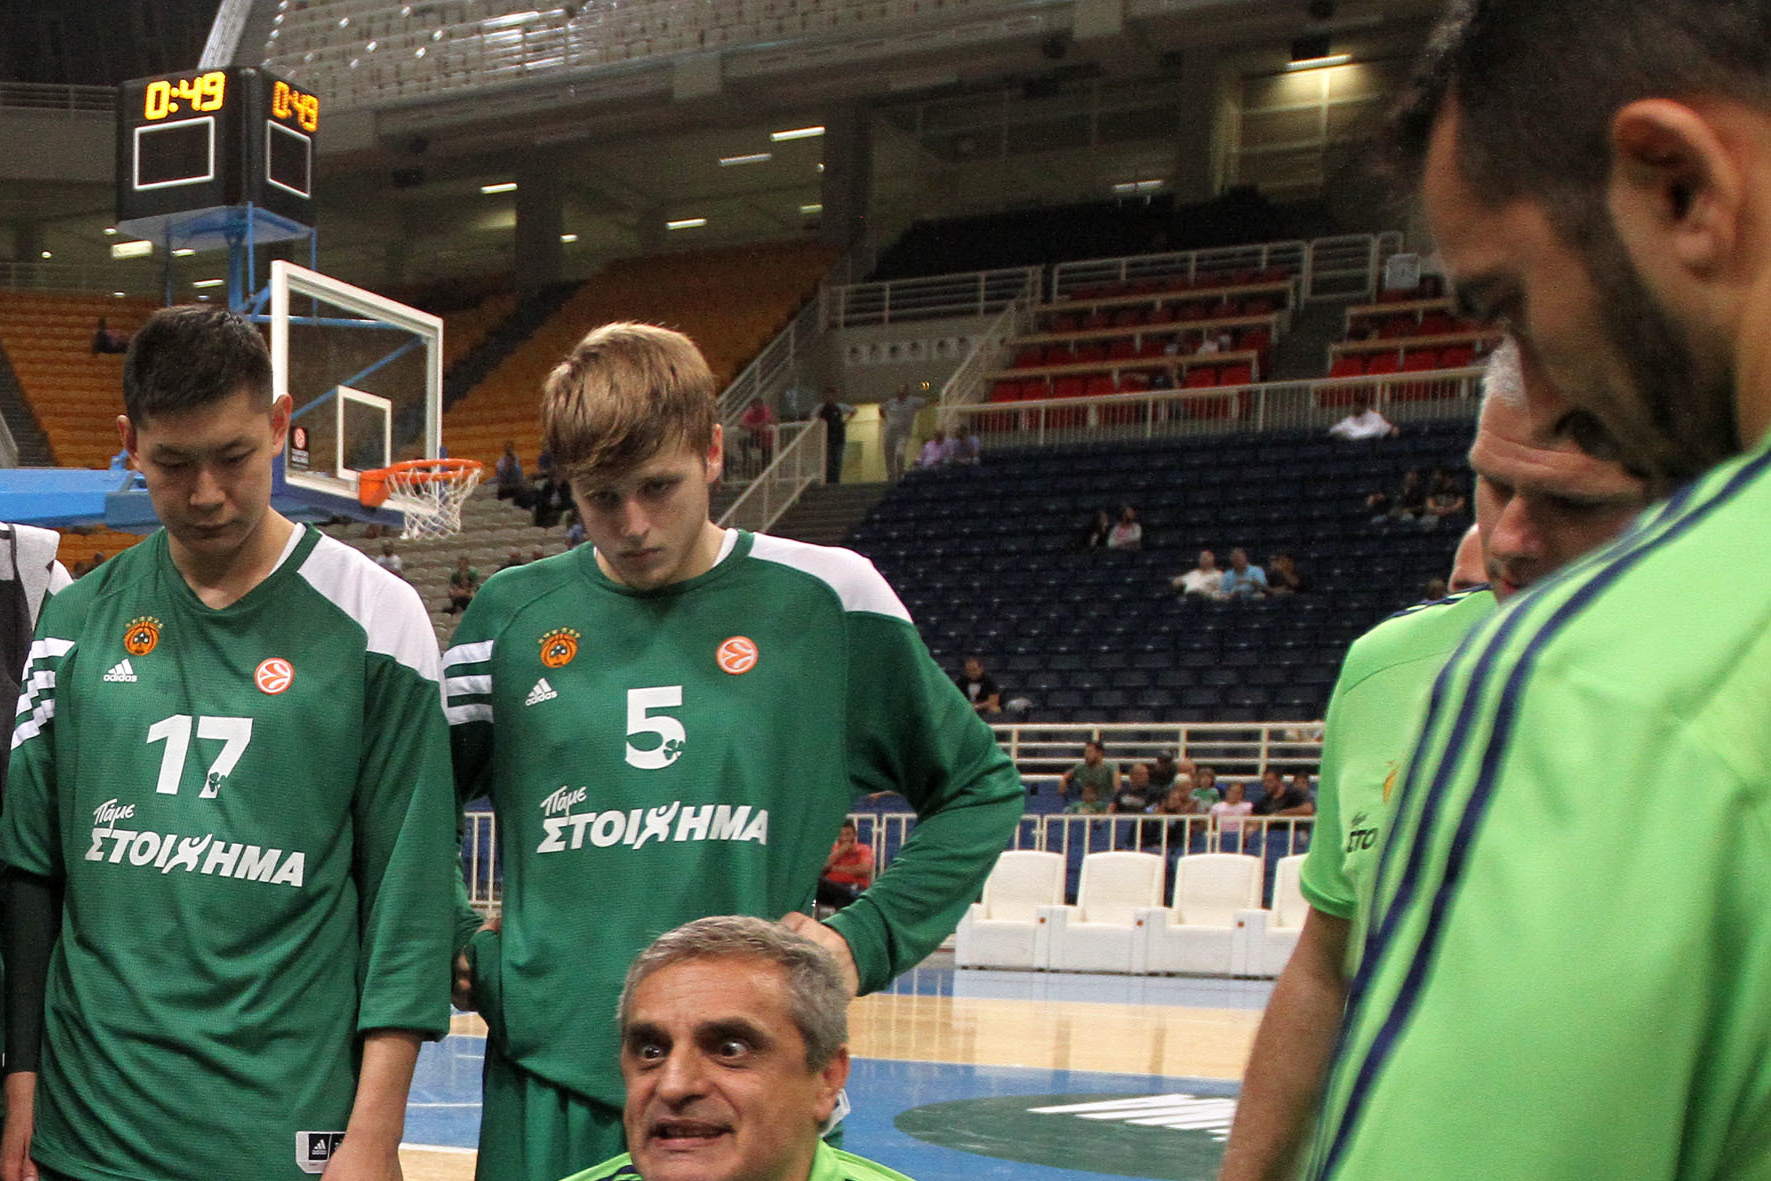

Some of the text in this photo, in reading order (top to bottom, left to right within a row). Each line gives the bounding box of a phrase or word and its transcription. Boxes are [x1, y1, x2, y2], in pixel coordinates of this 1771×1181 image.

[144, 71, 226, 120] 0:49
[272, 81, 320, 132] 0:49
[103, 673, 138, 682] adidas
[525, 690, 558, 706] adidas
[625, 685, 686, 770] 5
[146, 714, 254, 799] 17
